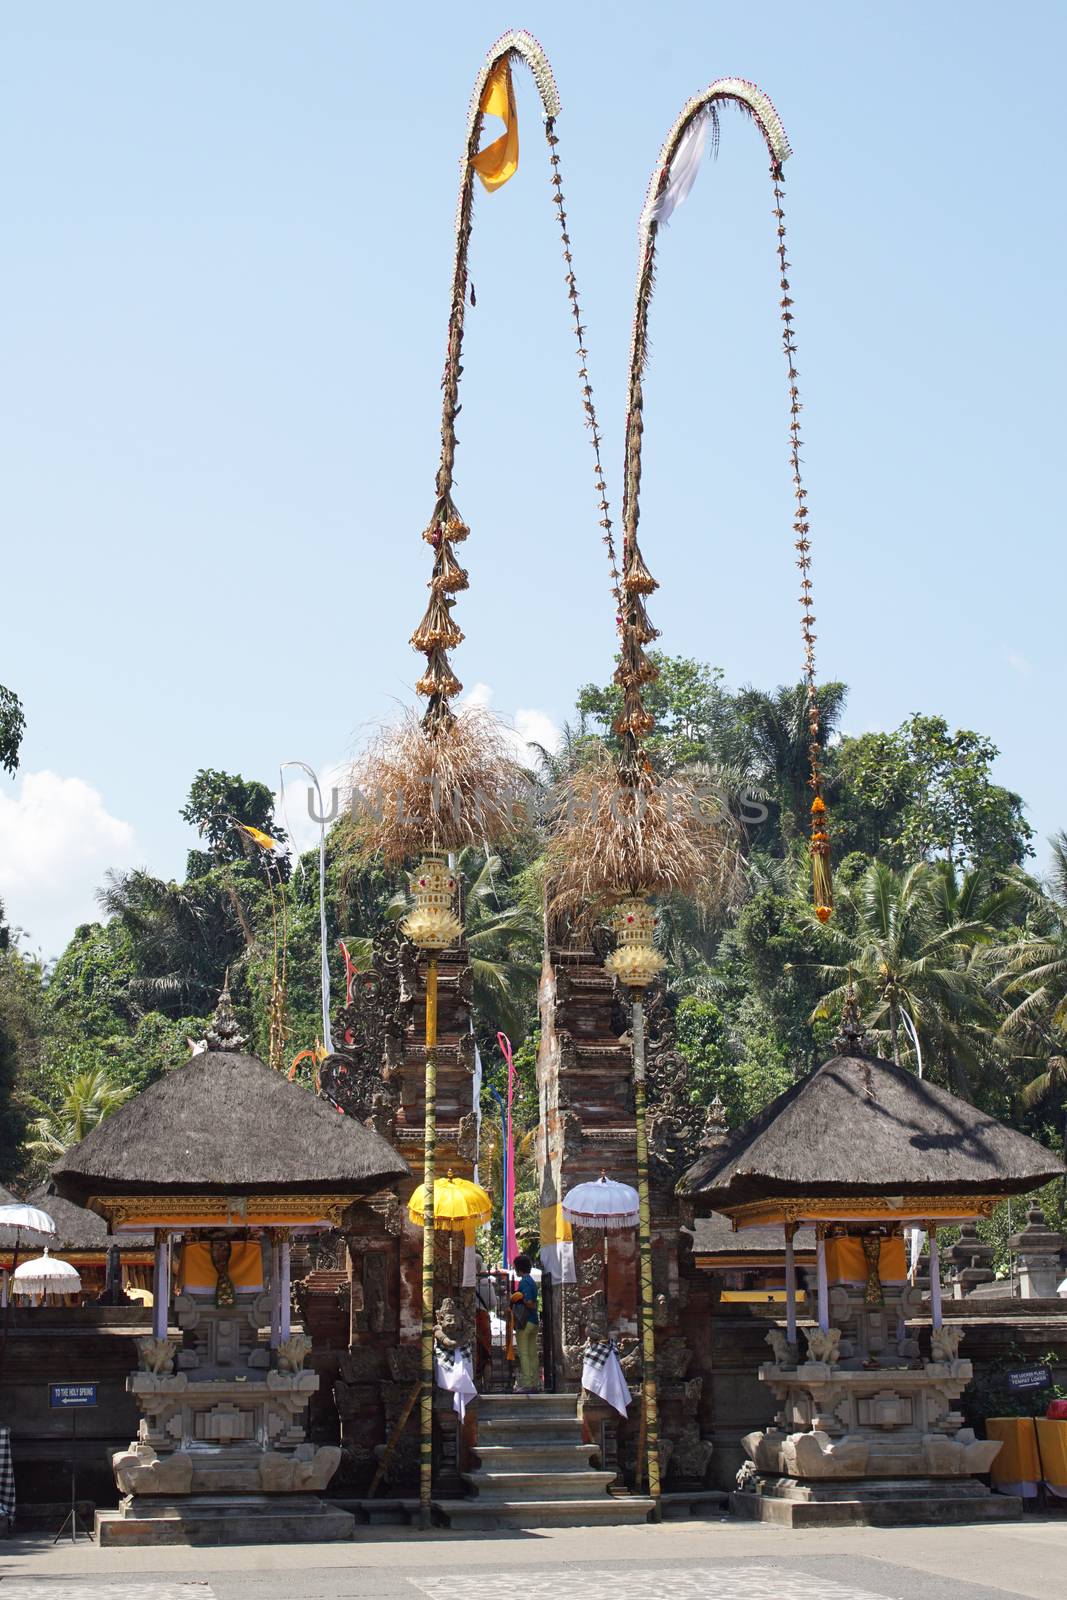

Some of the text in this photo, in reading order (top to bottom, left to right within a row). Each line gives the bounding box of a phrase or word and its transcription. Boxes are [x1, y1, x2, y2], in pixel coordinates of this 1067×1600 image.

[55, 1388, 60, 1397] TO
[69, 1388, 78, 1396] HOLY
[80, 1387, 93, 1396] SPRING
